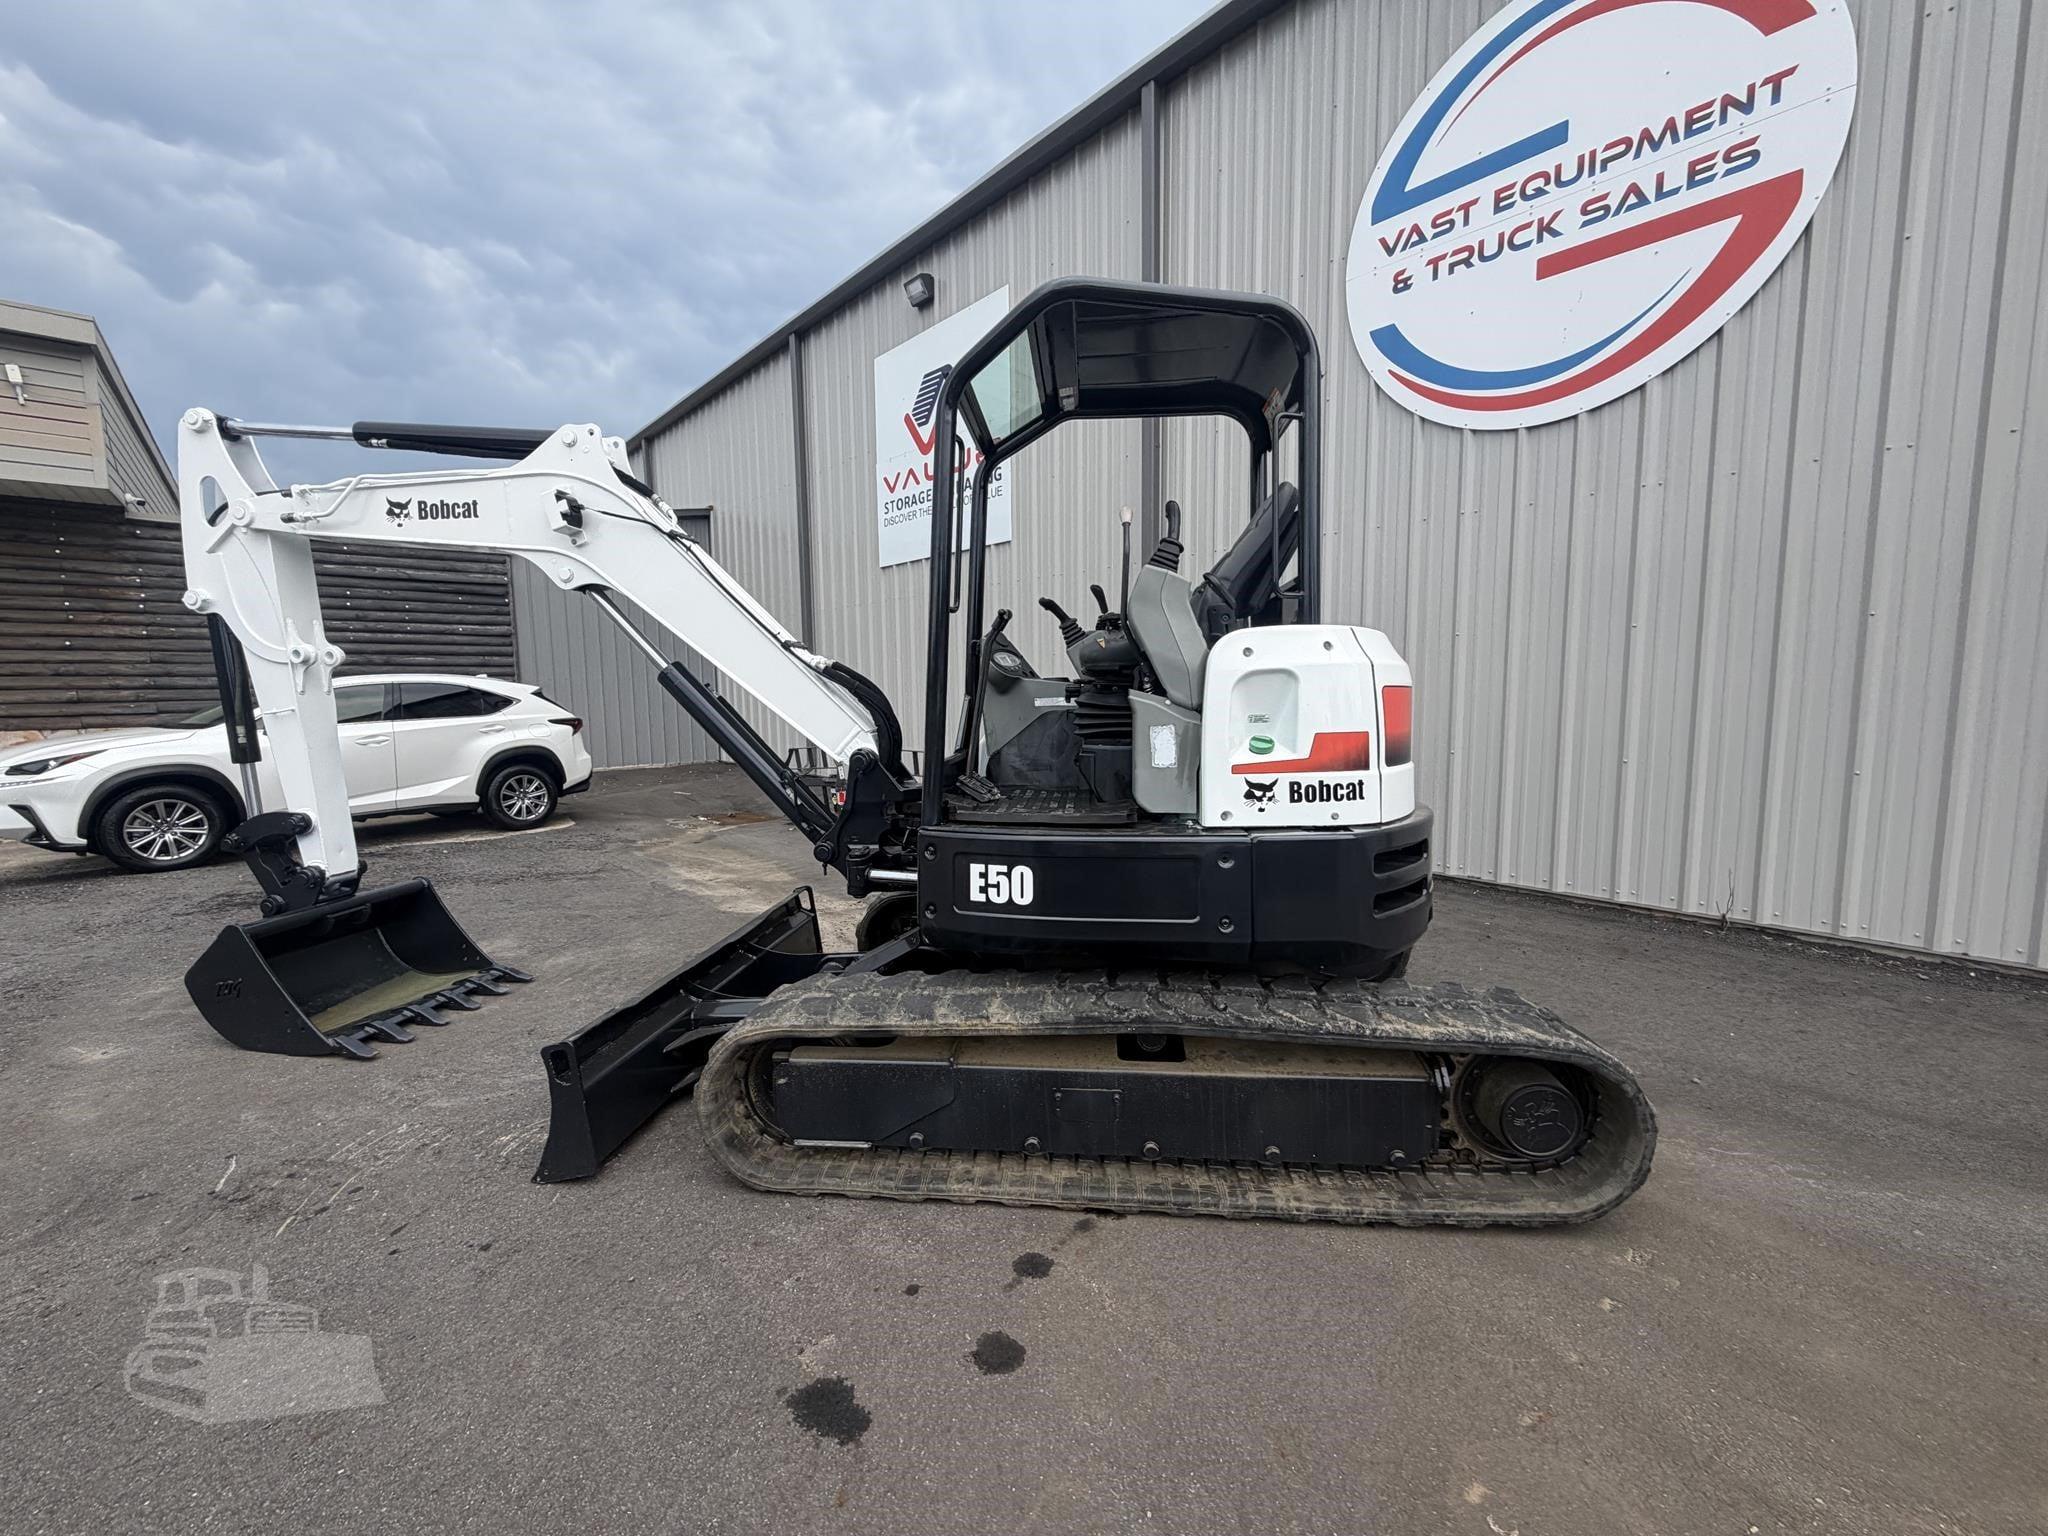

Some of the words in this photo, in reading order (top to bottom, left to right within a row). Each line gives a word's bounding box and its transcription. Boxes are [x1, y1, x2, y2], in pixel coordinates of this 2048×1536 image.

[1378, 196, 1480, 258] VAST
[1493, 63, 1800, 216] EQUIPMENT
[1391, 267, 1414, 295] &
[1424, 208, 1564, 282] TRUCK
[1578, 134, 1761, 230] SALES
[417, 499, 479, 521] Bobcat
[883, 488, 933, 516] STORAGE
[883, 509, 918, 528] DISCOVER
[918, 505, 933, 518] THE
[1288, 779, 1366, 804] Bobcat
[969, 863, 1034, 906] E50
